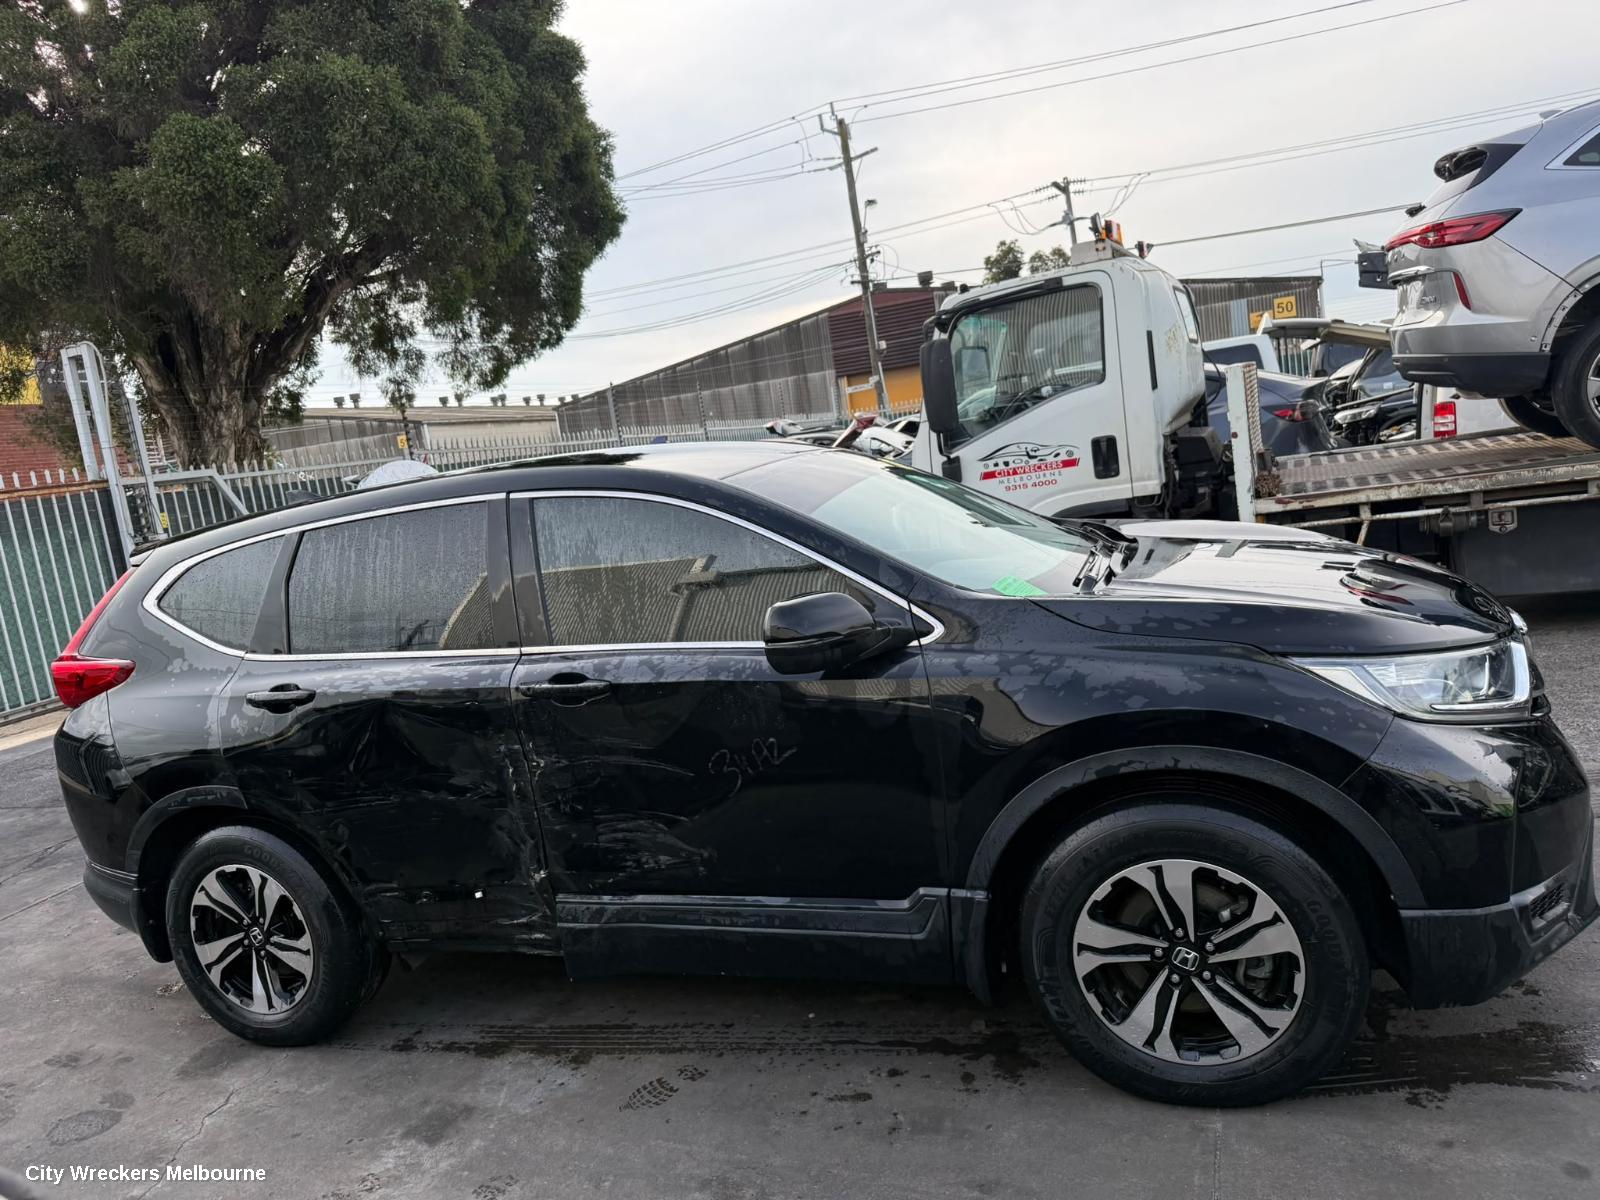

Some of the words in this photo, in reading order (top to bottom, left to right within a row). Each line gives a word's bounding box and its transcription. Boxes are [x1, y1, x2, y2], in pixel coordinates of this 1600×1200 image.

[1276, 300, 1294, 314] 50
[995, 469, 1015, 478] CITY
[1016, 461, 1063, 474] WRECKERS
[998, 471, 1063, 485] MELBOURNE
[1004, 482, 1028, 491] 9315
[1031, 479, 1057, 488] 4000
